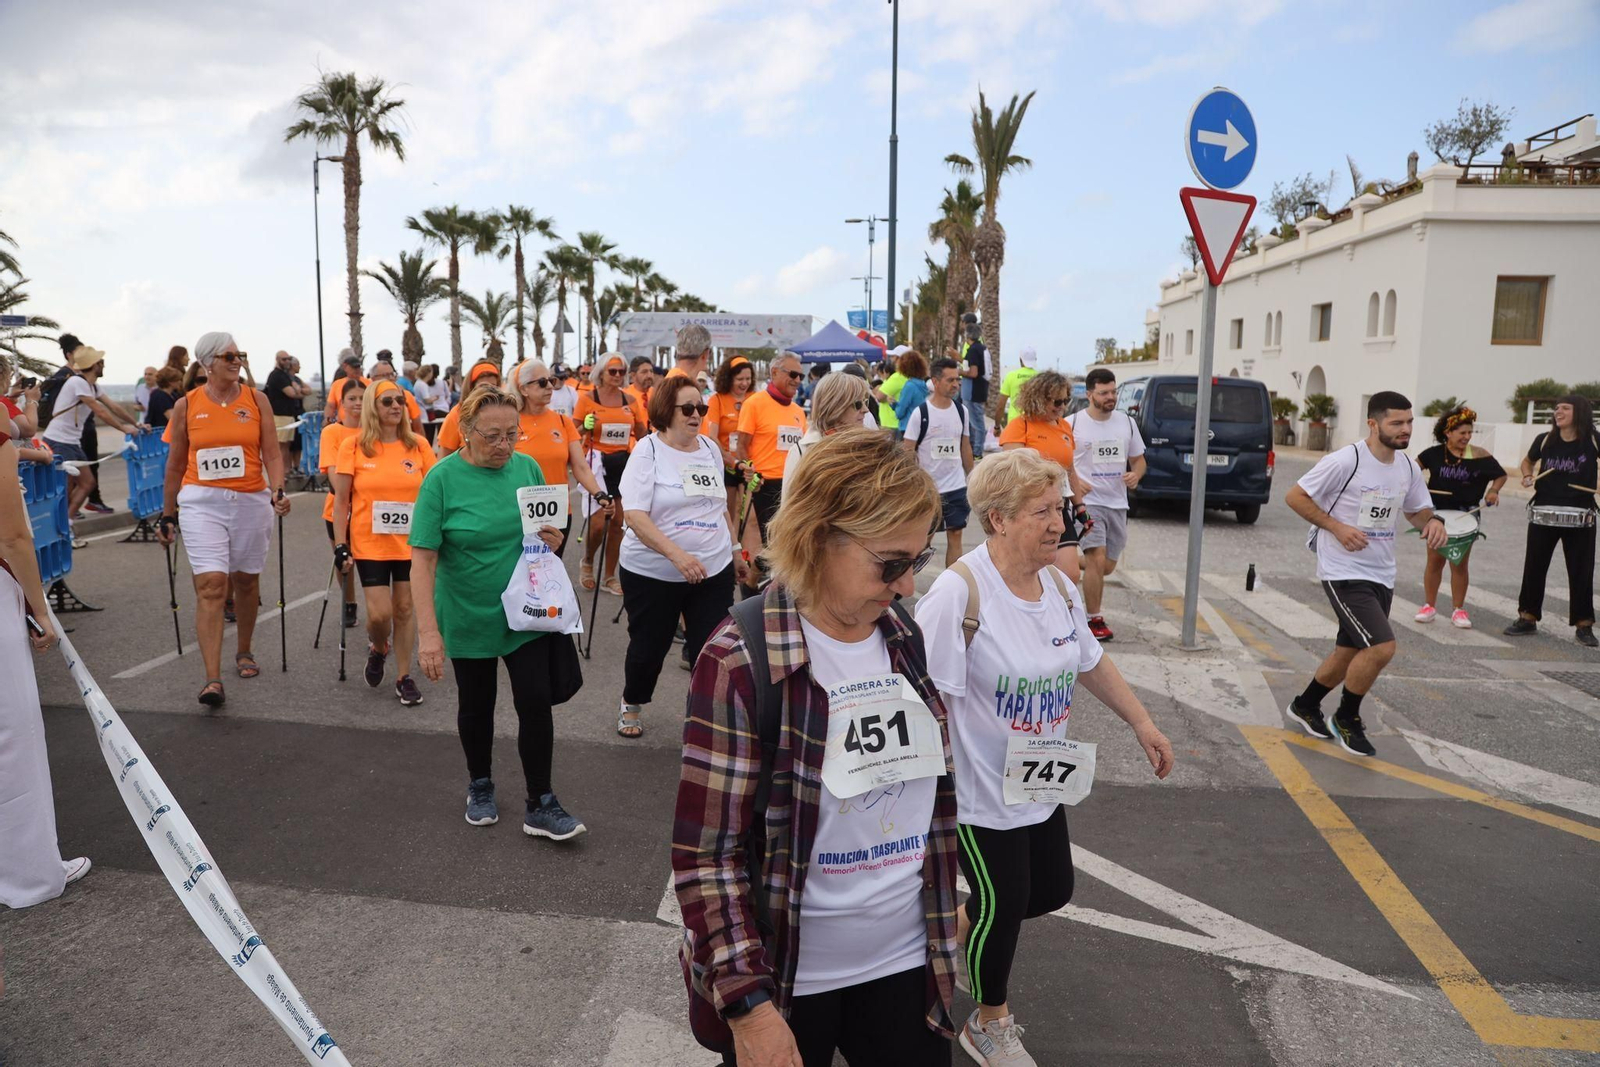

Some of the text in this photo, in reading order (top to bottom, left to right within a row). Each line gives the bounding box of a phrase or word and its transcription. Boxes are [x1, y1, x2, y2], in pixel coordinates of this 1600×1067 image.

[693, 318, 736, 326] CARRERA
[606, 430, 625, 438] 844
[937, 445, 955, 453] 741
[1098, 447, 1119, 456] 592
[201, 457, 241, 471] 1102
[1211, 455, 1226, 463] HNR
[691, 473, 718, 487] 981
[526, 500, 559, 519] 300
[1369, 506, 1392, 518] 591
[381, 512, 409, 525] 929
[839, 680, 883, 694] CARRERA
[884, 677, 900, 688] 5K
[1016, 675, 1052, 696] Ruta
[1055, 669, 1074, 690] de
[995, 690, 1033, 724] TAPA
[844, 710, 910, 756] 451
[900, 753, 919, 761] AMELIA
[1022, 760, 1077, 784] 747
[818, 849, 869, 865] DONACIÓN
[870, 835, 921, 860] TRASPLANTE
[822, 865, 857, 875] Memorial
[858, 863, 882, 871] Vicente
[882, 855, 914, 867] Granados
[266, 973, 315, 1042] Ayuntamiento de Málaga
